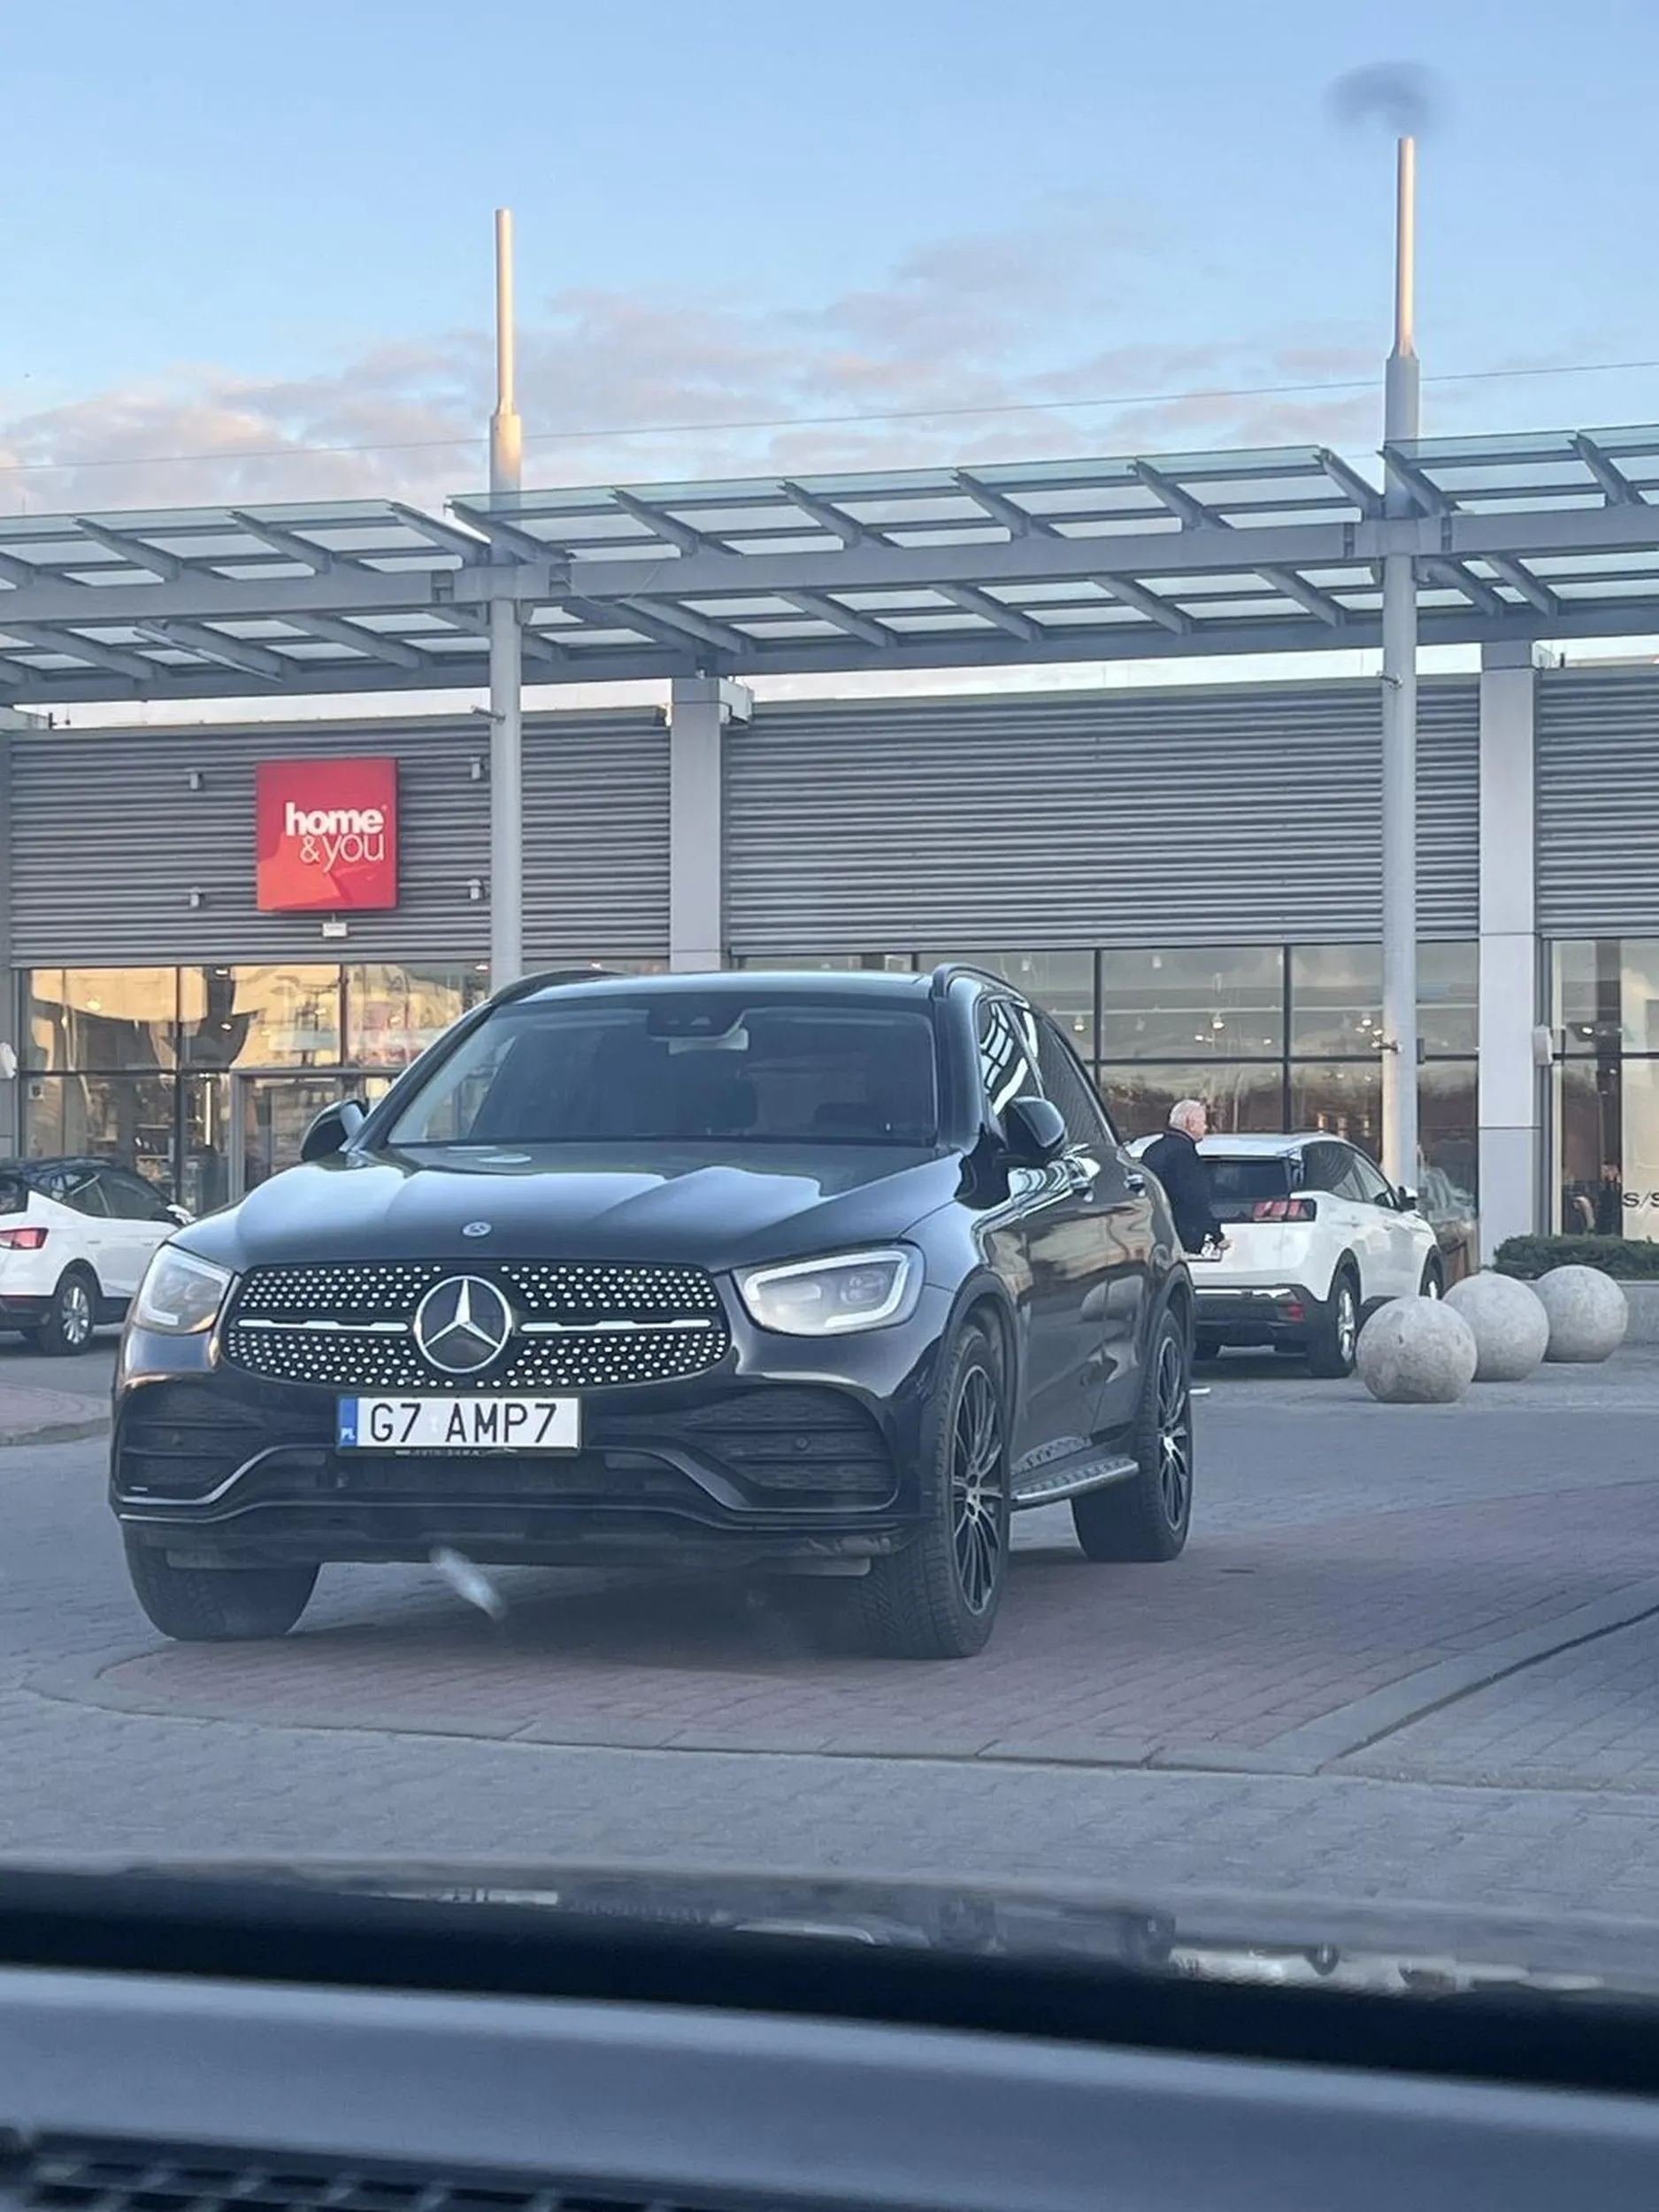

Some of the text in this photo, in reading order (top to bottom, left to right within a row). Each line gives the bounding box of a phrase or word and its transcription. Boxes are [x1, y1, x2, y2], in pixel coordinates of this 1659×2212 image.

[285, 802, 384, 836] home
[341, 1427, 356, 1441] PL
[371, 1402, 557, 1443] G7 AMP7
